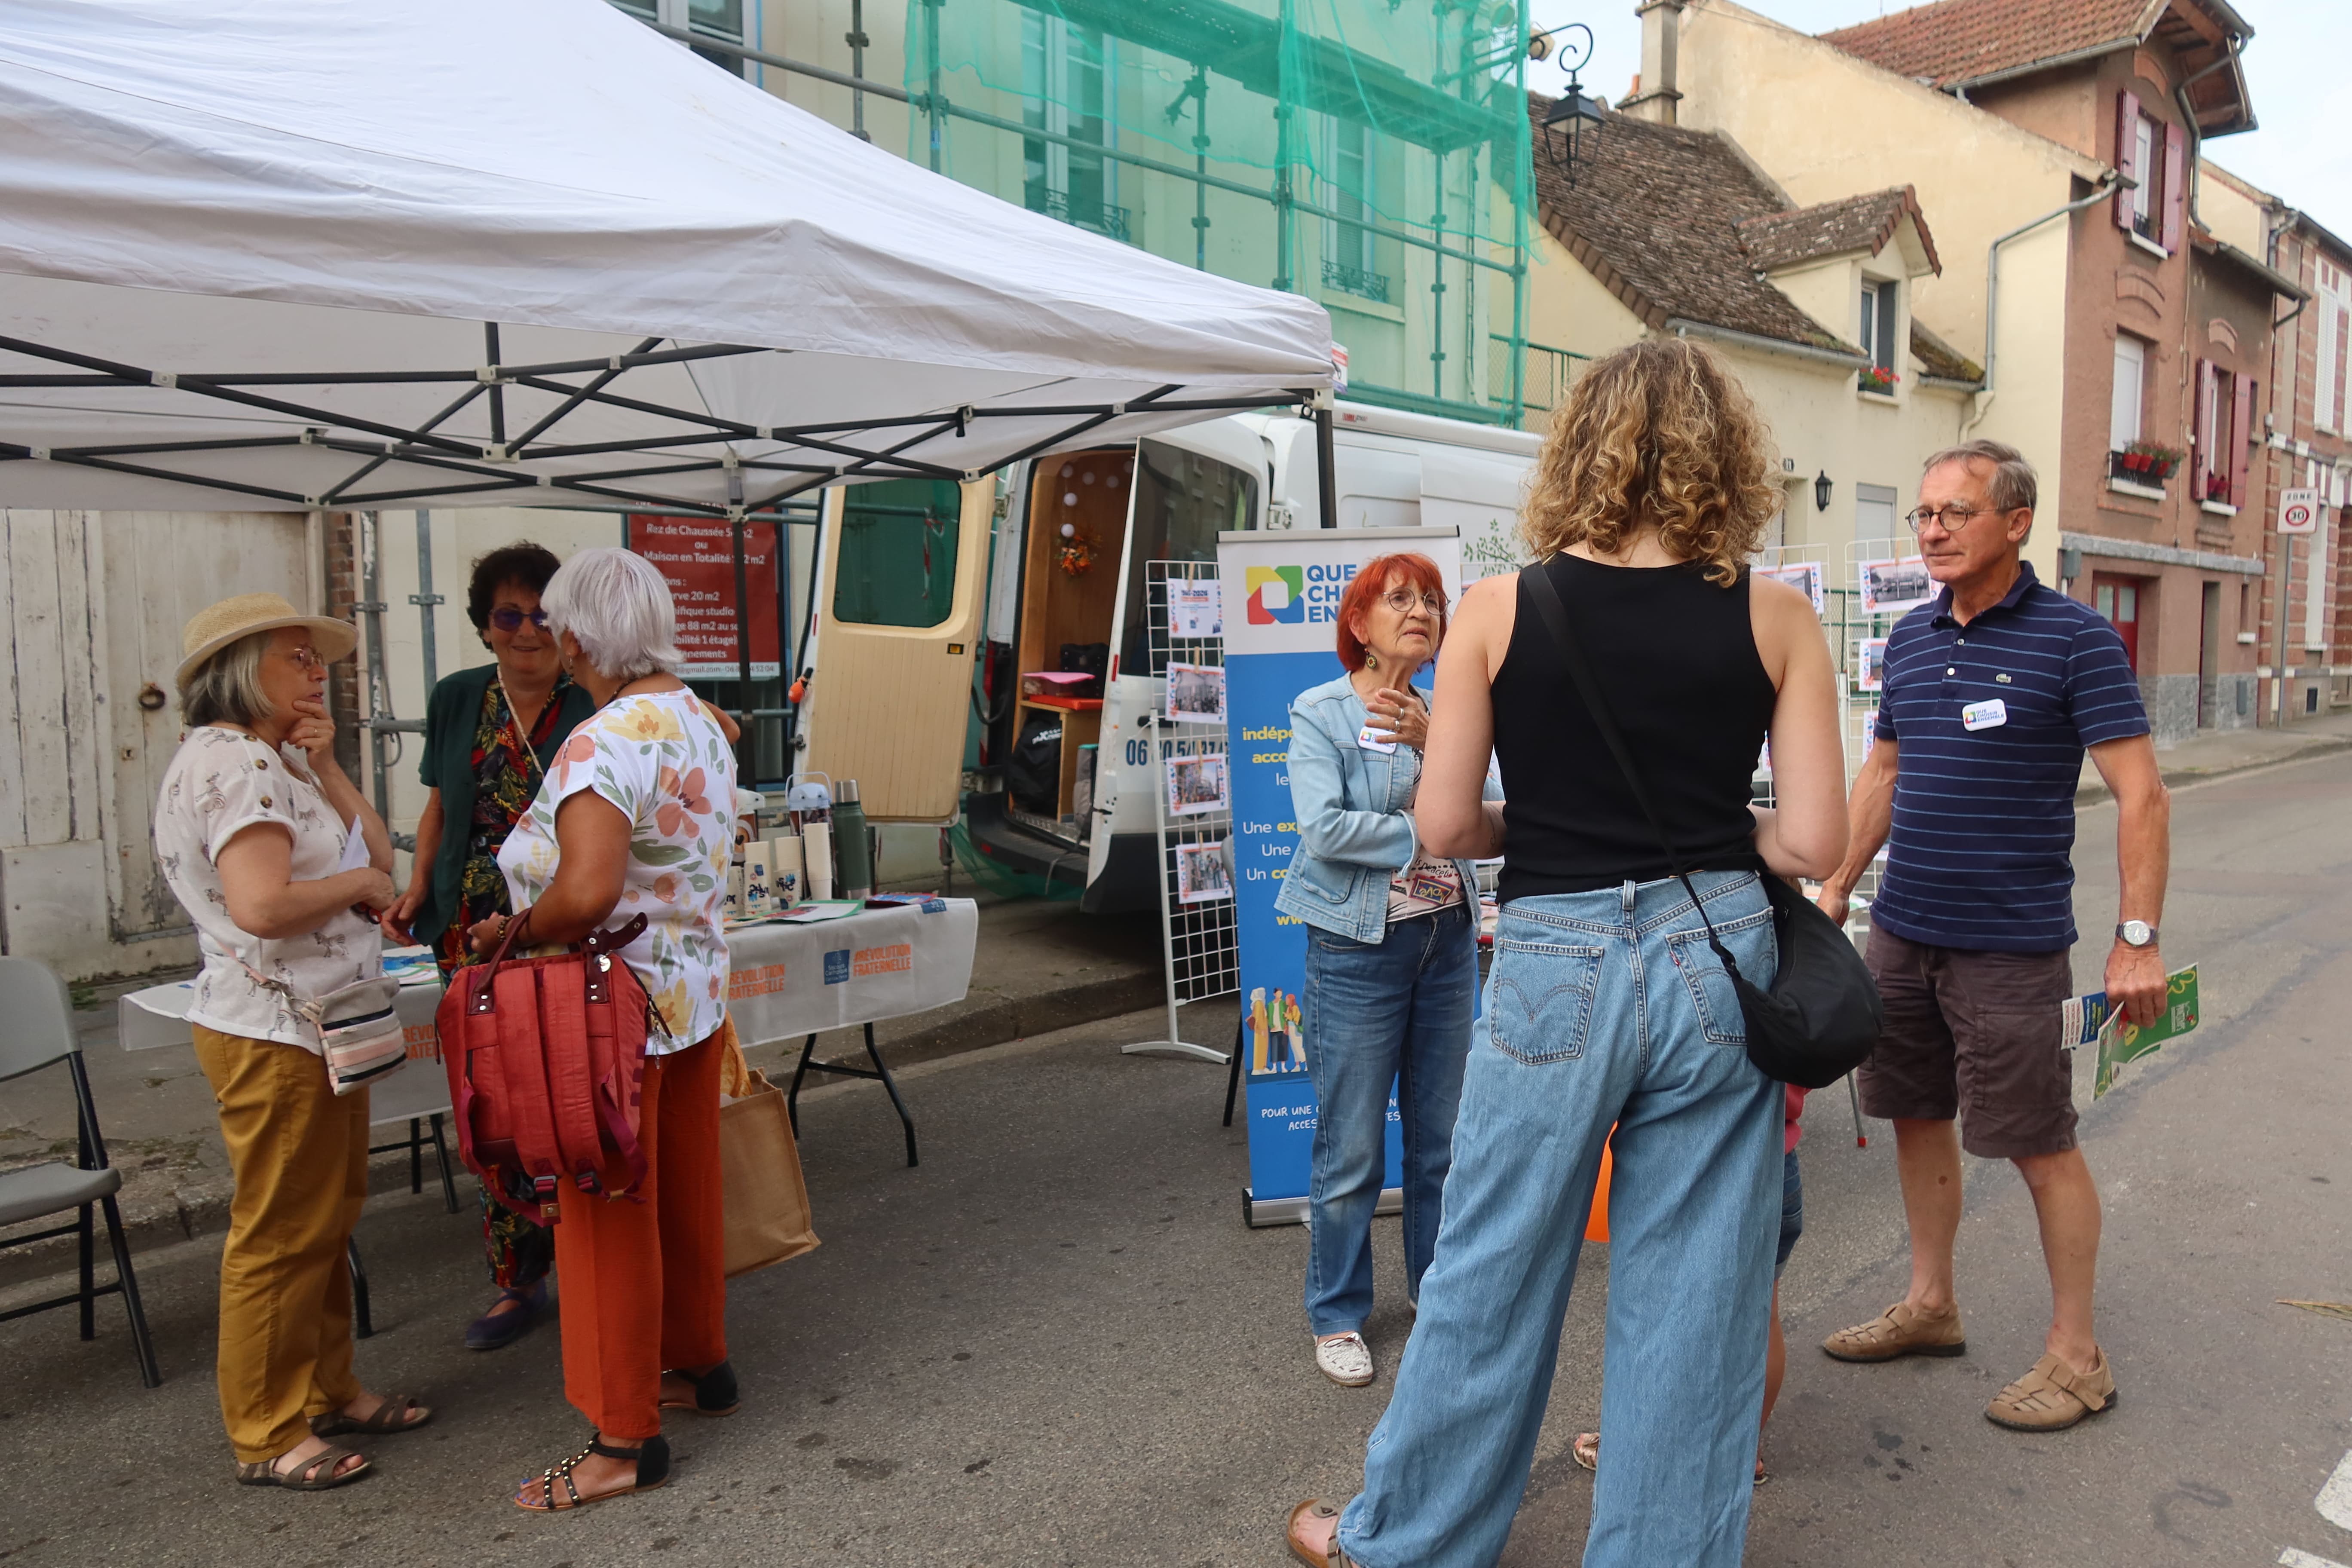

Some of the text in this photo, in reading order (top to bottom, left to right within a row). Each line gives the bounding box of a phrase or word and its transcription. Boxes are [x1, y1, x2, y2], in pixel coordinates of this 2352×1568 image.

[2287, 493, 2311, 501] ZONE
[646, 523, 663, 534] Rez
[665, 524, 677, 535] de
[679, 525, 723, 536] Chaussée
[695, 541, 708, 550] ou
[644, 550, 679, 561] Maison
[693, 552, 729, 564] Totalité
[750, 555, 765, 565] m2
[1307, 564, 1357, 582] QUE
[691, 591, 704, 601] 20
[705, 591, 720, 601] m2
[1308, 585, 1349, 602] CH
[706, 606, 735, 616] studio
[1308, 606, 1339, 622] EN
[701, 622, 716, 631] m2
[1126, 740, 1148, 766] 06
[1252, 753, 1288, 763] acco
[1243, 821, 1272, 834] Une
[1262, 844, 1291, 857] Une
[1246, 868, 1267, 881] Un
[1261, 1107, 1288, 1118] POUR
[1291, 1105, 1312, 1116] UNE
[1288, 1119, 1318, 1131] ACCES
